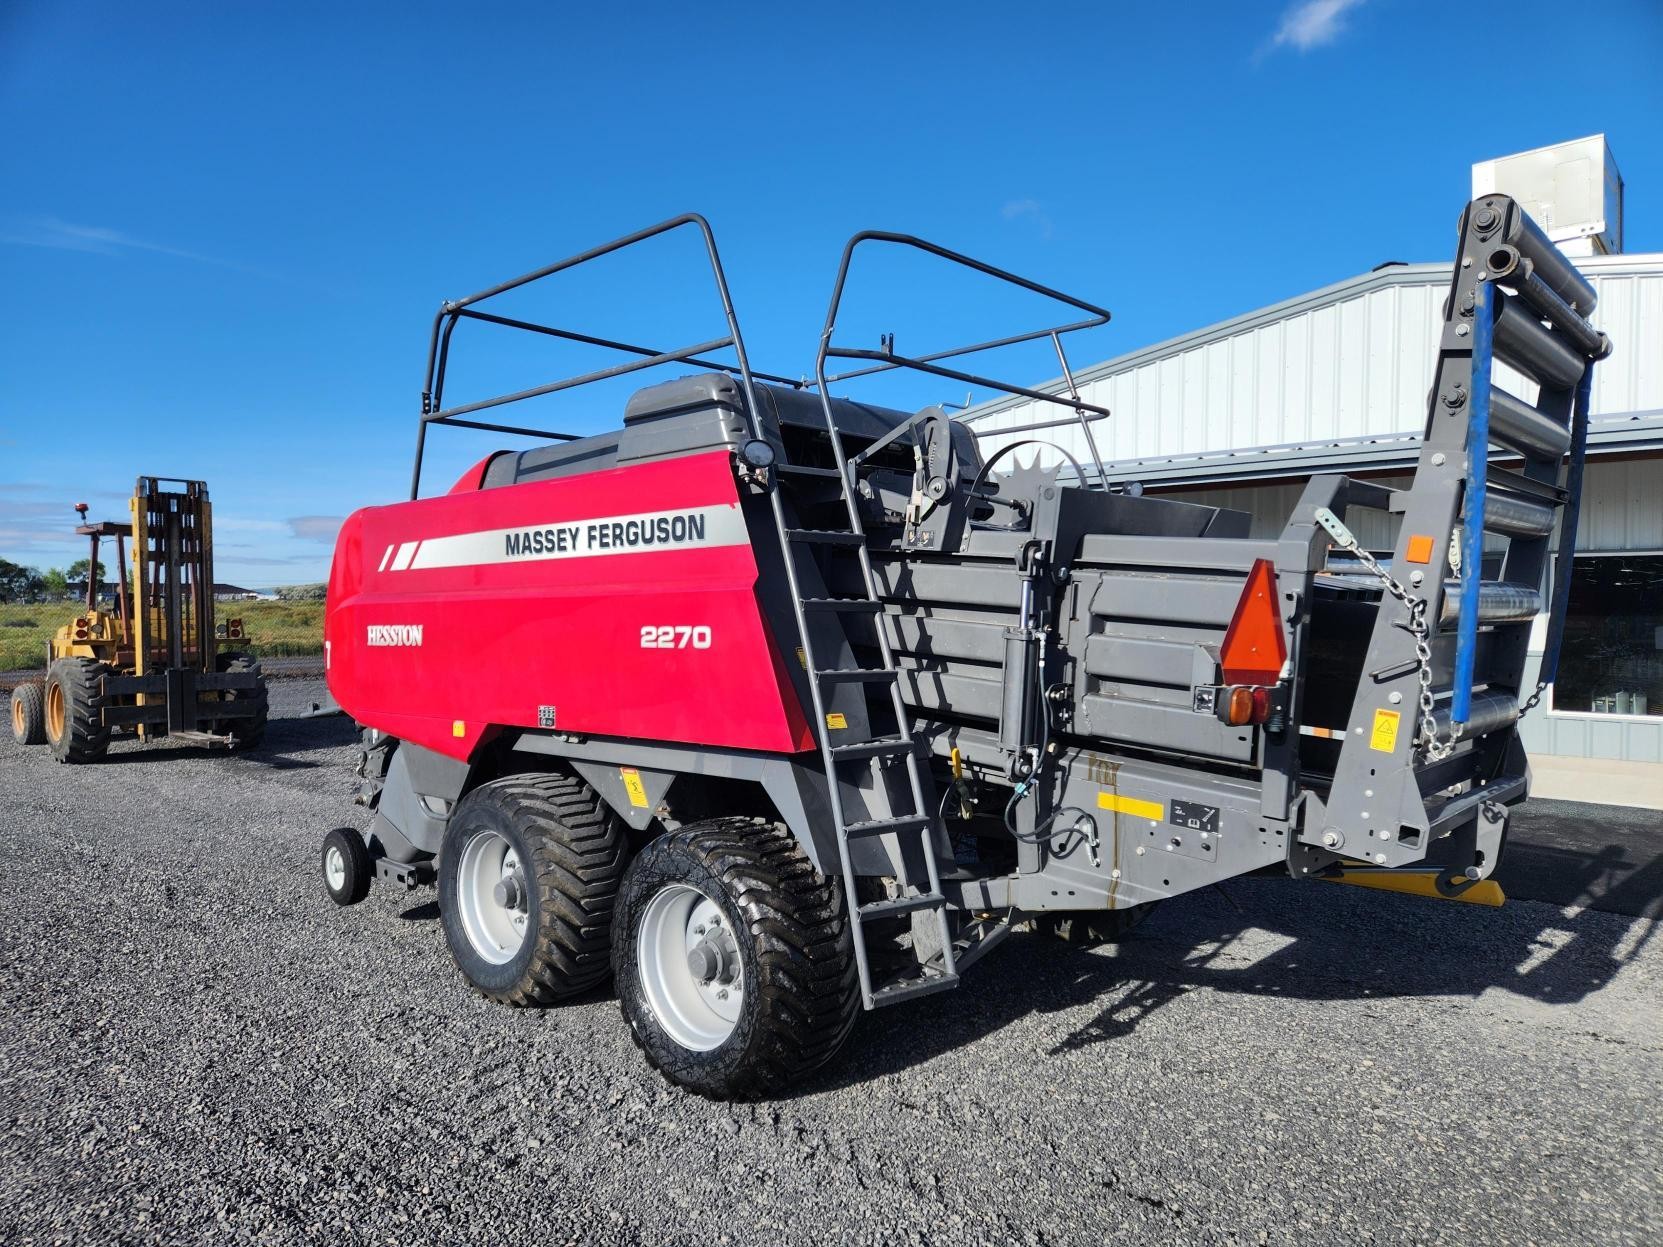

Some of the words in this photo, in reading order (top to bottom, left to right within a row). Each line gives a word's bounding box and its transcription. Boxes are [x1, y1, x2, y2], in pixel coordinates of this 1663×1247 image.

[505, 527, 580, 556] MASSEY
[587, 513, 705, 549] FERGUSON
[367, 624, 423, 646] HESSTON
[640, 625, 711, 649] 2270
